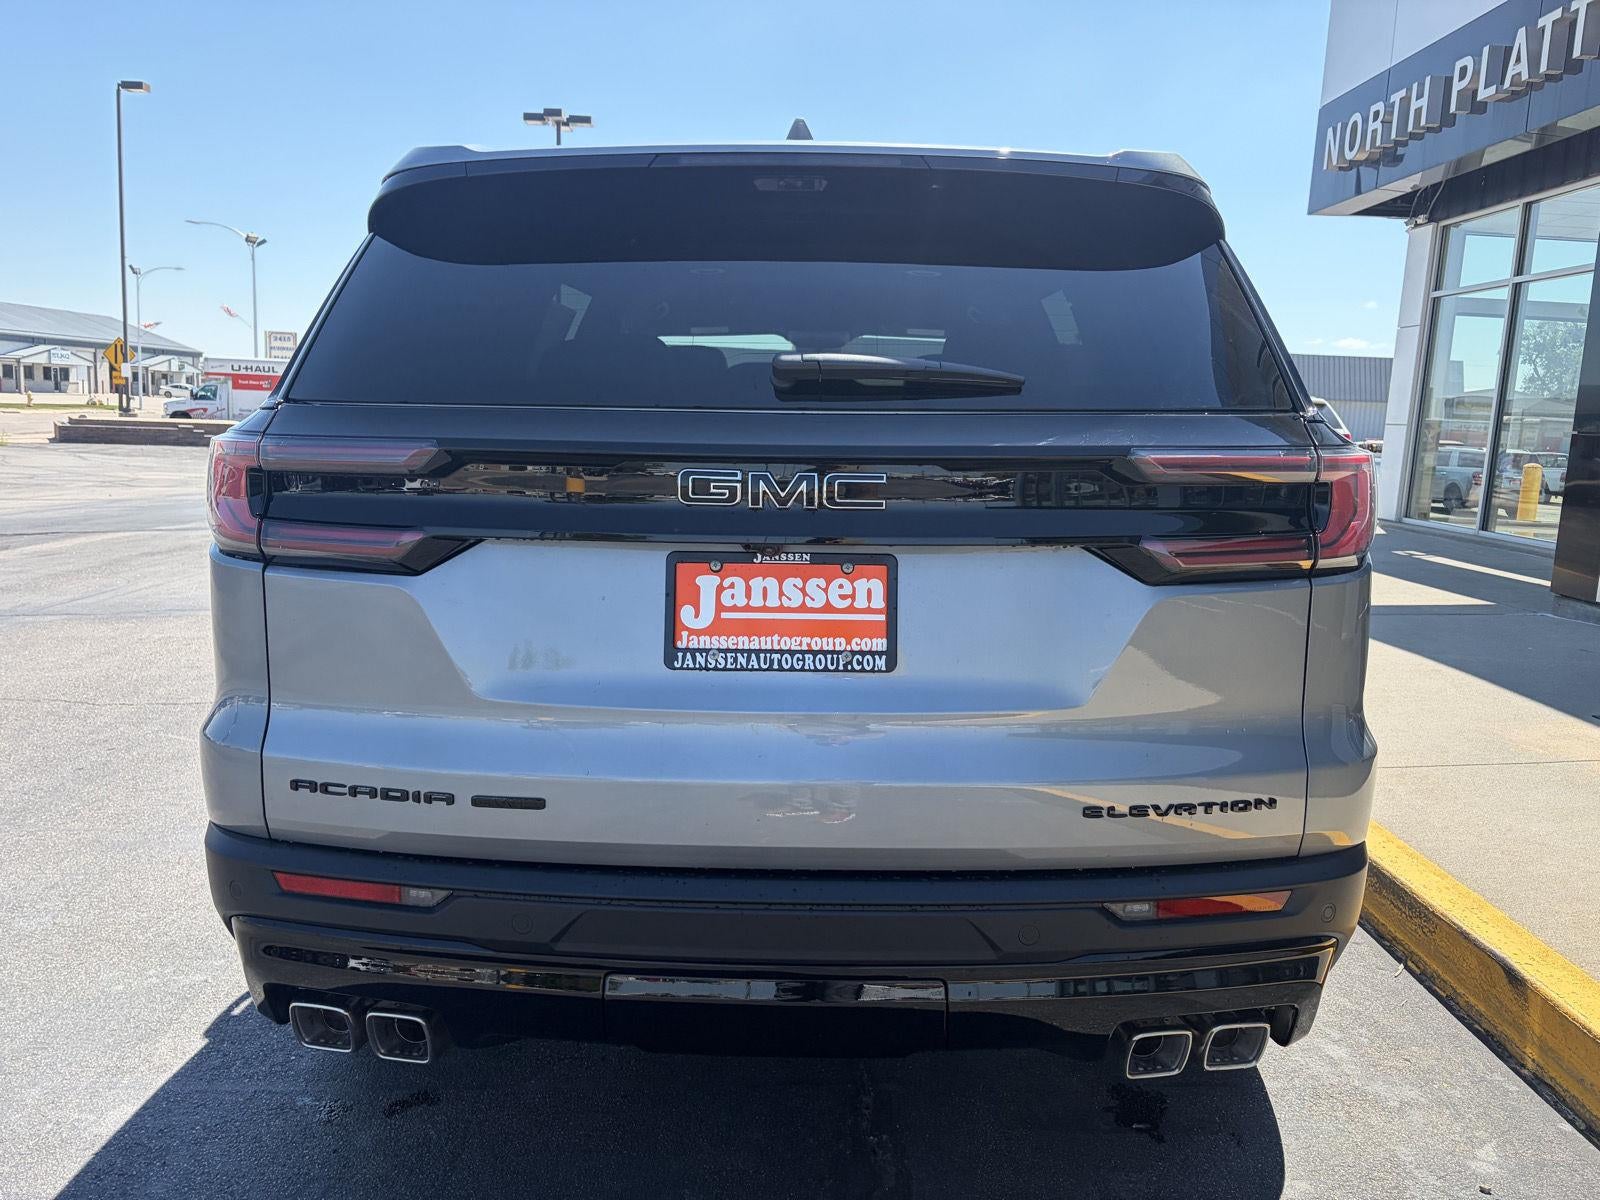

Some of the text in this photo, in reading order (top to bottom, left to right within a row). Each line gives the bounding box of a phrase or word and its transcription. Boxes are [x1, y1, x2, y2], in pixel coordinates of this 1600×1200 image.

[1323, 75, 1432, 170] NORTH
[231, 364, 278, 374] U-HAUL
[677, 467, 888, 510] GMC
[680, 574, 886, 630] Janssen
[676, 630, 888, 651] Janssenautogroup.com
[289, 778, 456, 806] ACADIA
[1081, 797, 1278, 819] ELEVATION
